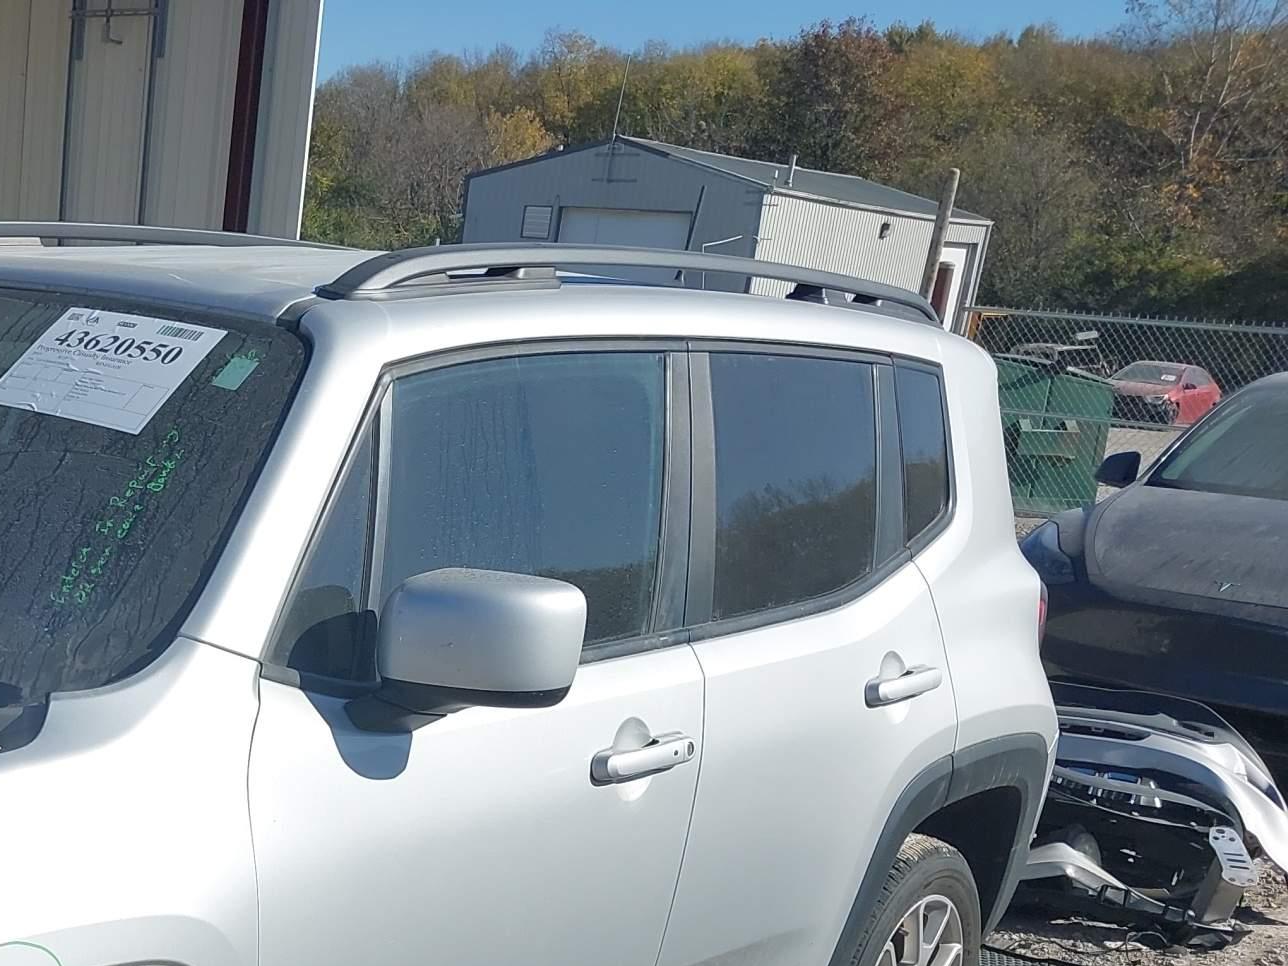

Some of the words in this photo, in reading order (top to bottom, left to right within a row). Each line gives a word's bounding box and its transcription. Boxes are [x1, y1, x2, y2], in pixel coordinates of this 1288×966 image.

[37, 344, 78, 358] Progressive
[100, 354, 132, 366] Insurance
[55, 329, 183, 365] 43620550
